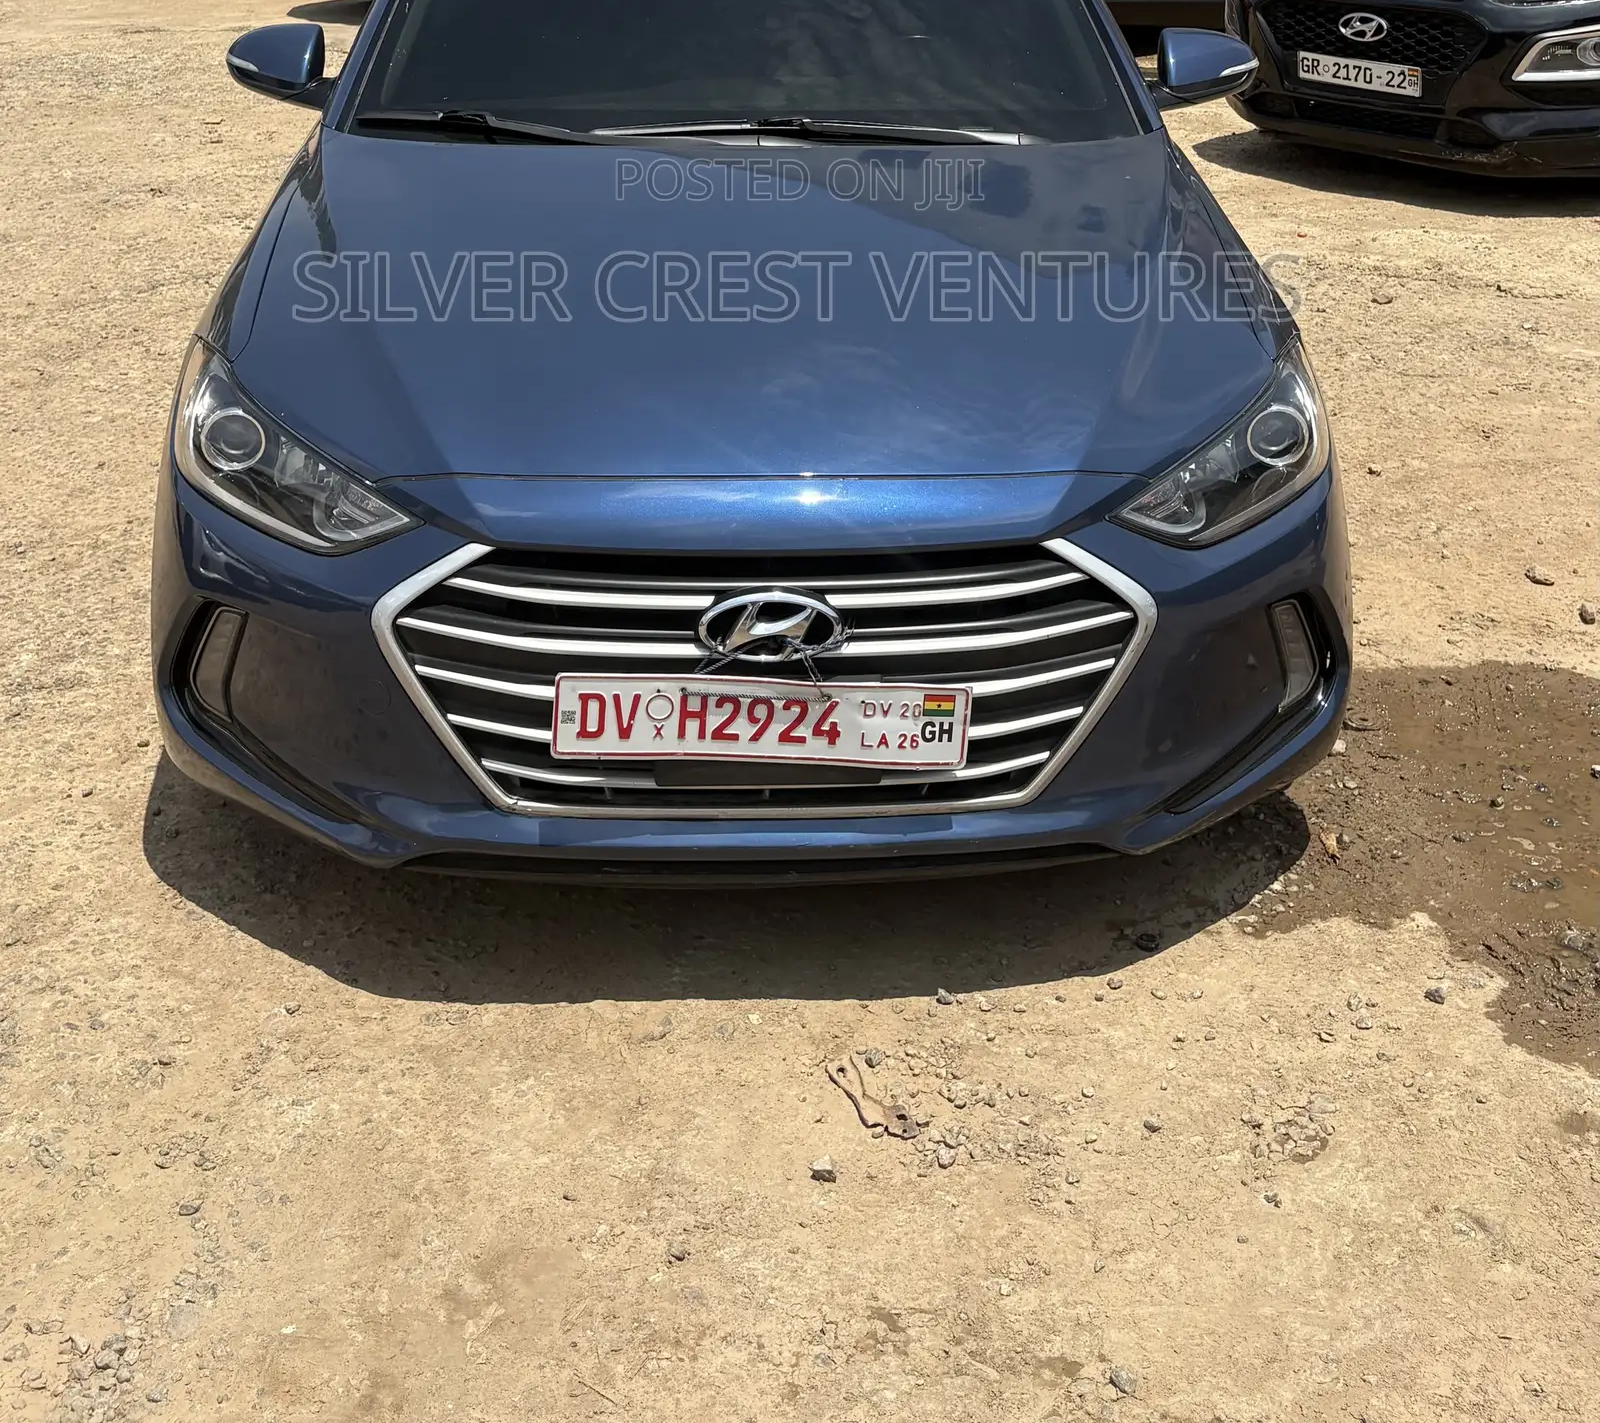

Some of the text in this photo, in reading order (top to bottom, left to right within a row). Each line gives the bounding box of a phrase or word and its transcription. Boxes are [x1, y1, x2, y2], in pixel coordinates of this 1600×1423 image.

[1301, 57, 1321, 76] GR
[576, 692, 642, 740] DV
[863, 701, 922, 719] DV 20
[860, 732, 920, 749] LA 26
[920, 721, 954, 743] GH
